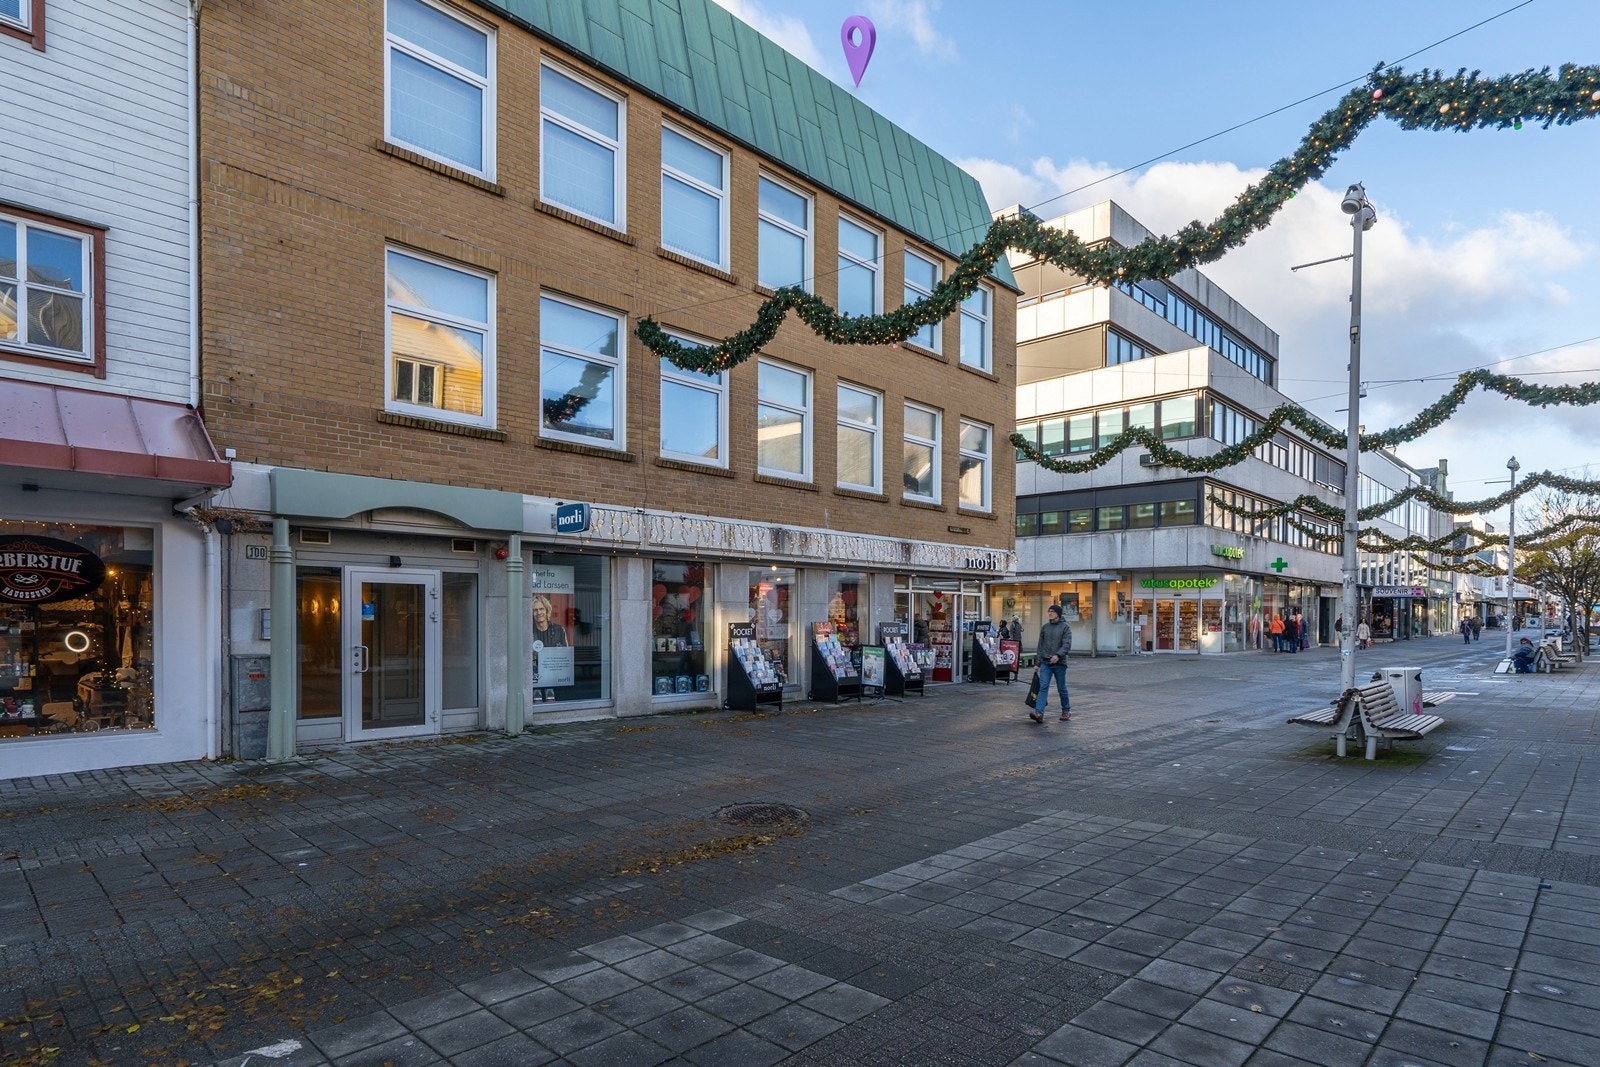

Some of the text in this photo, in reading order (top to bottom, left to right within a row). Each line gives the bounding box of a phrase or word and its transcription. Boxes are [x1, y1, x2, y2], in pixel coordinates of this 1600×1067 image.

[558, 509, 582, 526] norli
[249, 547, 266, 559] 100
[967, 552, 998, 570] norli
[546, 570, 555, 578] fra
[544, 581, 570, 589] Larssen
[1141, 578, 1213, 590] vitusapotek
[2, 586, 52, 599] HAUGESUND
[733, 628, 753, 636] POCKET
